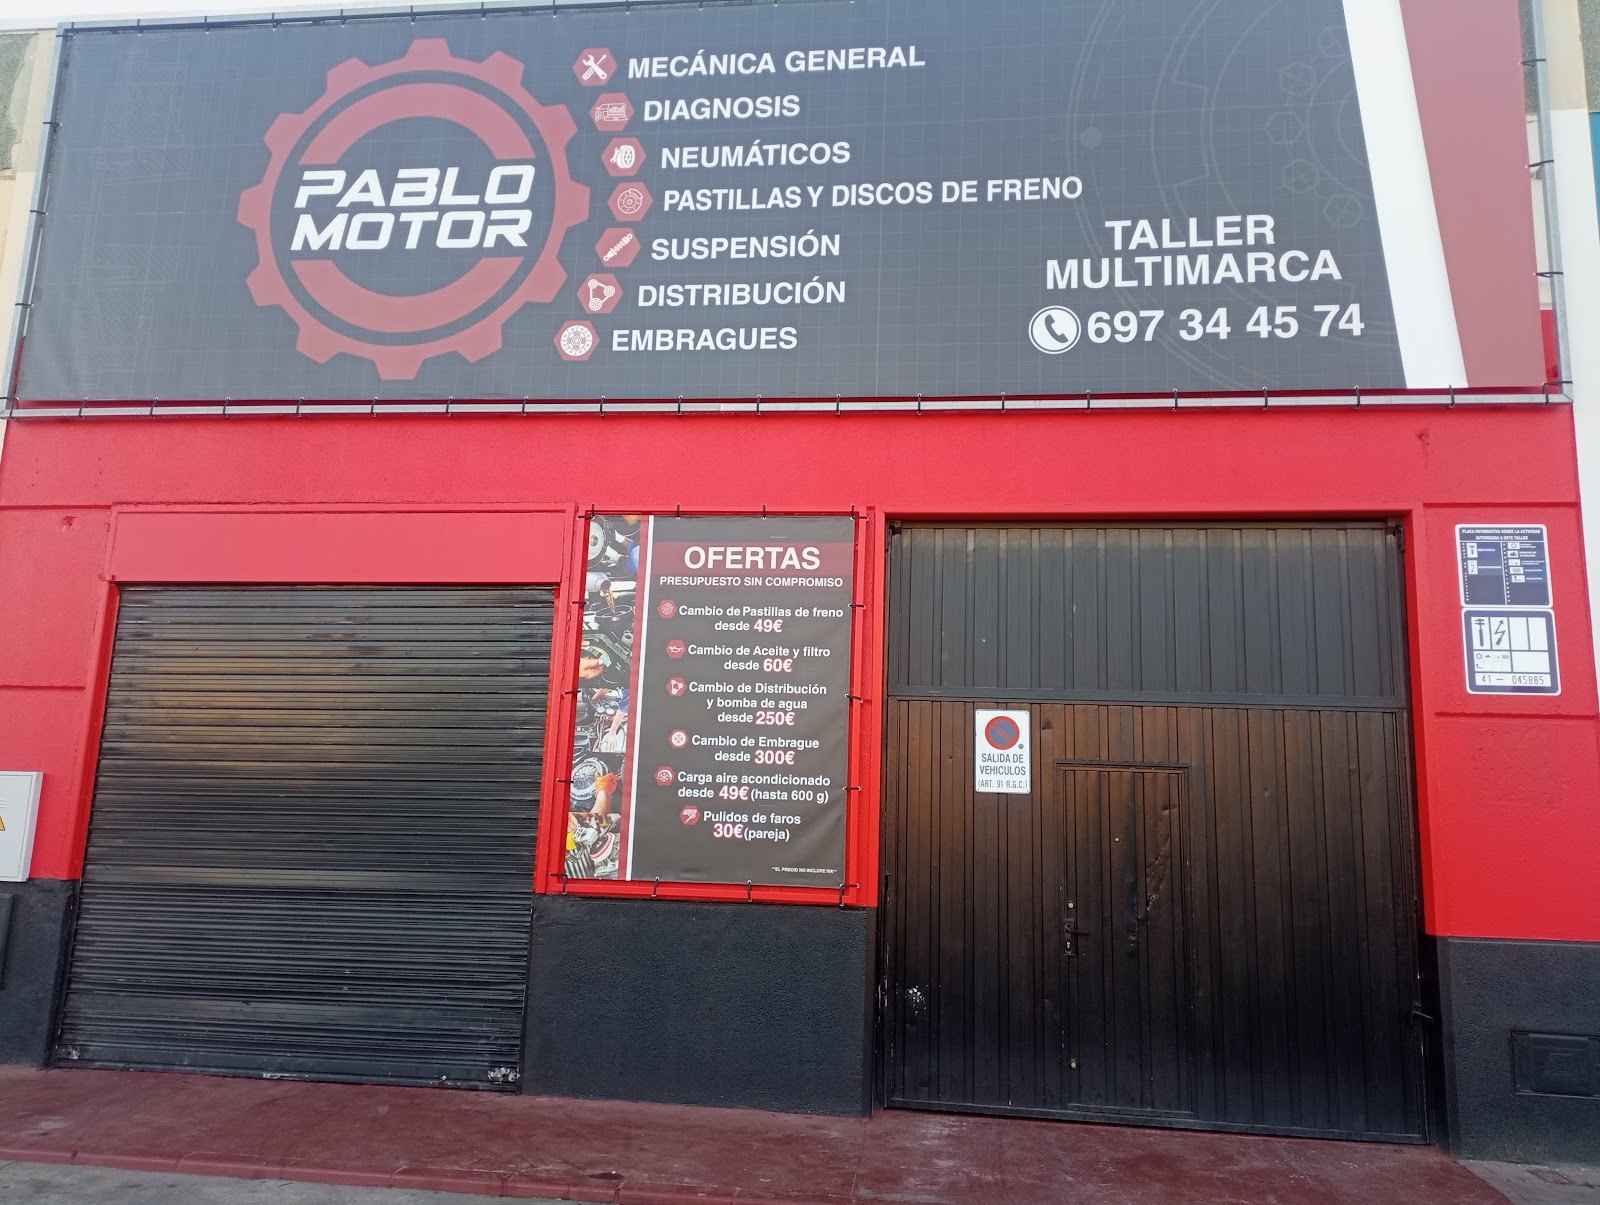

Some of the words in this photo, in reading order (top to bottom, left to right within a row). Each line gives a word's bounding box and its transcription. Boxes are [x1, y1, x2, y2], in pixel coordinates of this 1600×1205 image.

[628, 50, 776, 80] MECÁNICA
[785, 46, 925, 75] GENERAL
[643, 95, 801, 122] DIAGNOSIS
[661, 140, 850, 169] NEUMÁTICOS
[294, 165, 536, 208] PABLO
[663, 186, 802, 212] PASTILLAS
[807, 186, 825, 207] Y
[831, 181, 933, 207] DISCOS
[942, 180, 979, 205] DE
[987, 175, 1084, 202] FRENO
[290, 209, 533, 251] MOTOR
[1105, 214, 1276, 250] TALLER
[651, 229, 841, 261] SUSPENSIÓN
[1046, 249, 1343, 290] MULTIMARCA
[637, 276, 847, 308] DISTRIBUCIÓN
[1087, 309, 1165, 344] 697
[1179, 307, 1231, 340] 34
[1246, 305, 1299, 339] 45
[1313, 303, 1365, 337] 74
[611, 326, 799, 353] EMBRAGUES
[684, 546, 820, 569] OFERTAS
[659, 575, 741, 587] PRESUPUESTO
[744, 576, 762, 587] SIN
[764, 577, 844, 588] COMPROMISO
[679, 605, 723, 617] Cambio
[726, 605, 741, 617] de
[742, 606, 792, 618] Pastillas
[795, 606, 810, 618] de
[812, 606, 844, 619] freno
[714, 620, 750, 633] desde
[754, 618, 783, 634] 49€
[688, 643, 733, 656] Cambio
[736, 644, 750, 656] de
[753, 645, 789, 657] Aceite
[792, 648, 800, 659] y
[802, 645, 831, 658] filtro
[724, 659, 760, 671] desde
[763, 657, 793, 673] 60€
[1482, 674, 1491, 684] 41
[689, 682, 734, 694] Cambio
[737, 682, 751, 694] de
[755, 682, 827, 696] Distribución
[706, 699, 714, 710] y
[717, 697, 757, 709] bomba
[760, 698, 775, 709] de
[778, 700, 808, 711] agua
[717, 711, 754, 723] desde
[755, 711, 795, 726] 250€
[692, 735, 737, 747] Cambio
[740, 735, 755, 747] de
[758, 736, 820, 751] Embrague
[714, 750, 751, 762] desde
[754, 750, 795, 765] 300€
[981, 753, 1010, 763] SALIDA
[1013, 754, 1023, 763] DE
[677, 771, 713, 785] Carga
[715, 772, 738, 784] aire
[741, 772, 831, 786] acondicionado
[979, 765, 1026, 776] VEHICULOS
[978, 779, 994, 788] (ART.
[997, 780, 1003, 788] 91
[677, 786, 714, 799] desde
[719, 785, 749, 800] 49€
[750, 787, 788, 802] (hasta
[791, 789, 813, 802] 600
[816, 789, 829, 804] g)
[703, 811, 748, 823] Pulidos
[752, 811, 767, 823] de
[769, 812, 801, 825] faros
[713, 823, 743, 839] 30€
[744, 827, 789, 842] (pareja)
